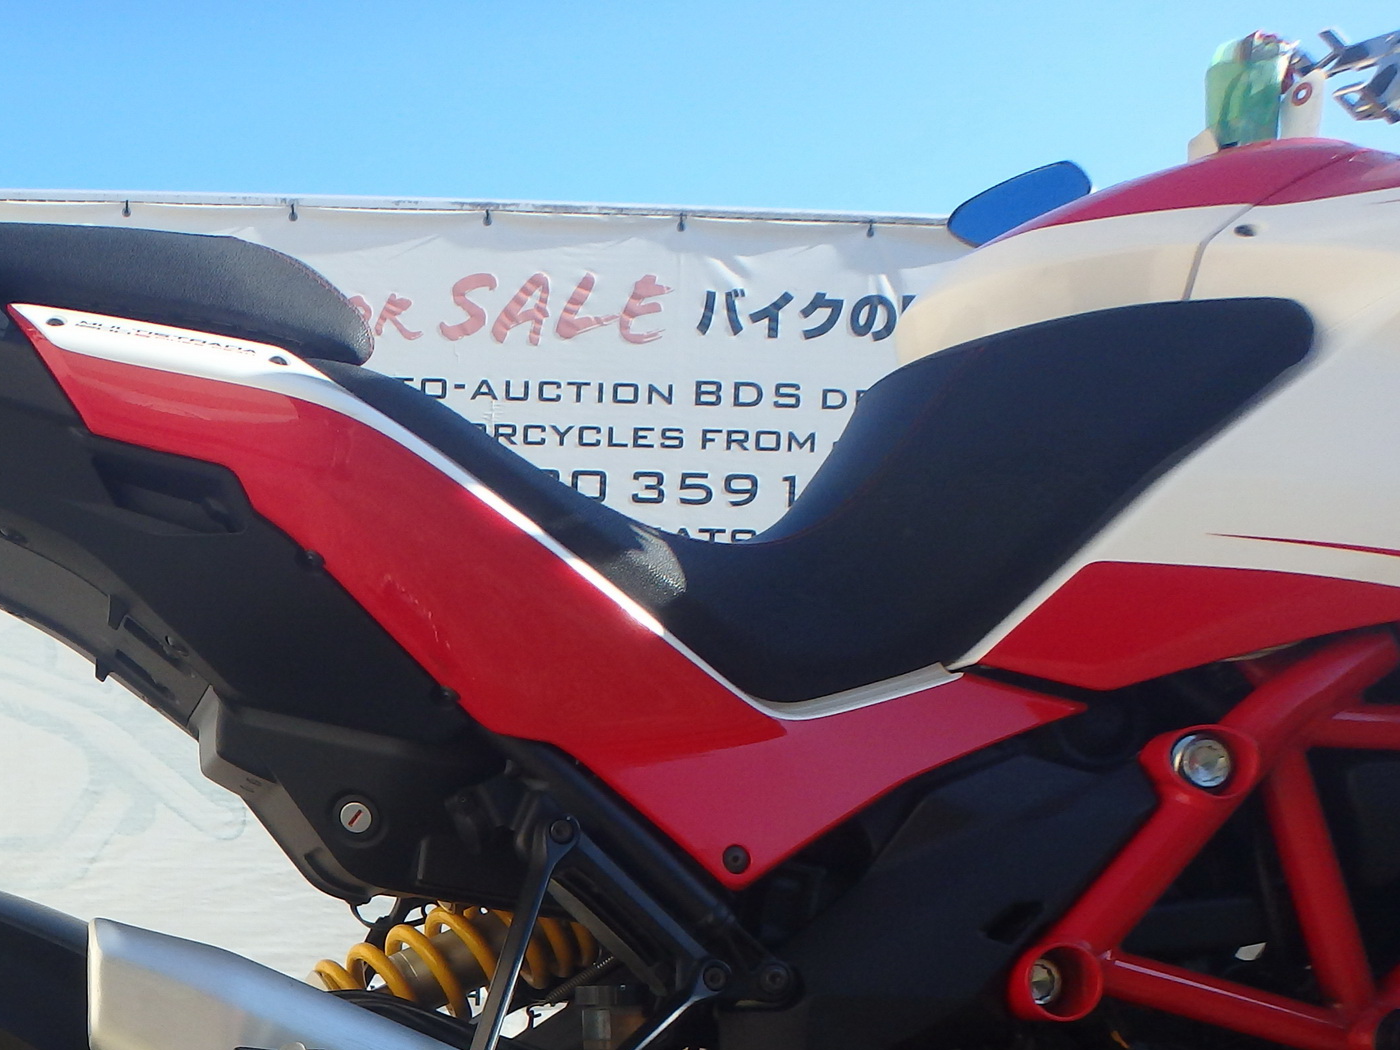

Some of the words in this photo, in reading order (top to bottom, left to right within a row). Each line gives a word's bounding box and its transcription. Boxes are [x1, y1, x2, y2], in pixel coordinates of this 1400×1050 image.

[439, 272, 674, 346] SALE
[696, 288, 916, 342] バイクの
[694, 380, 802, 409] BDS
[701, 428, 816, 453] FROM
